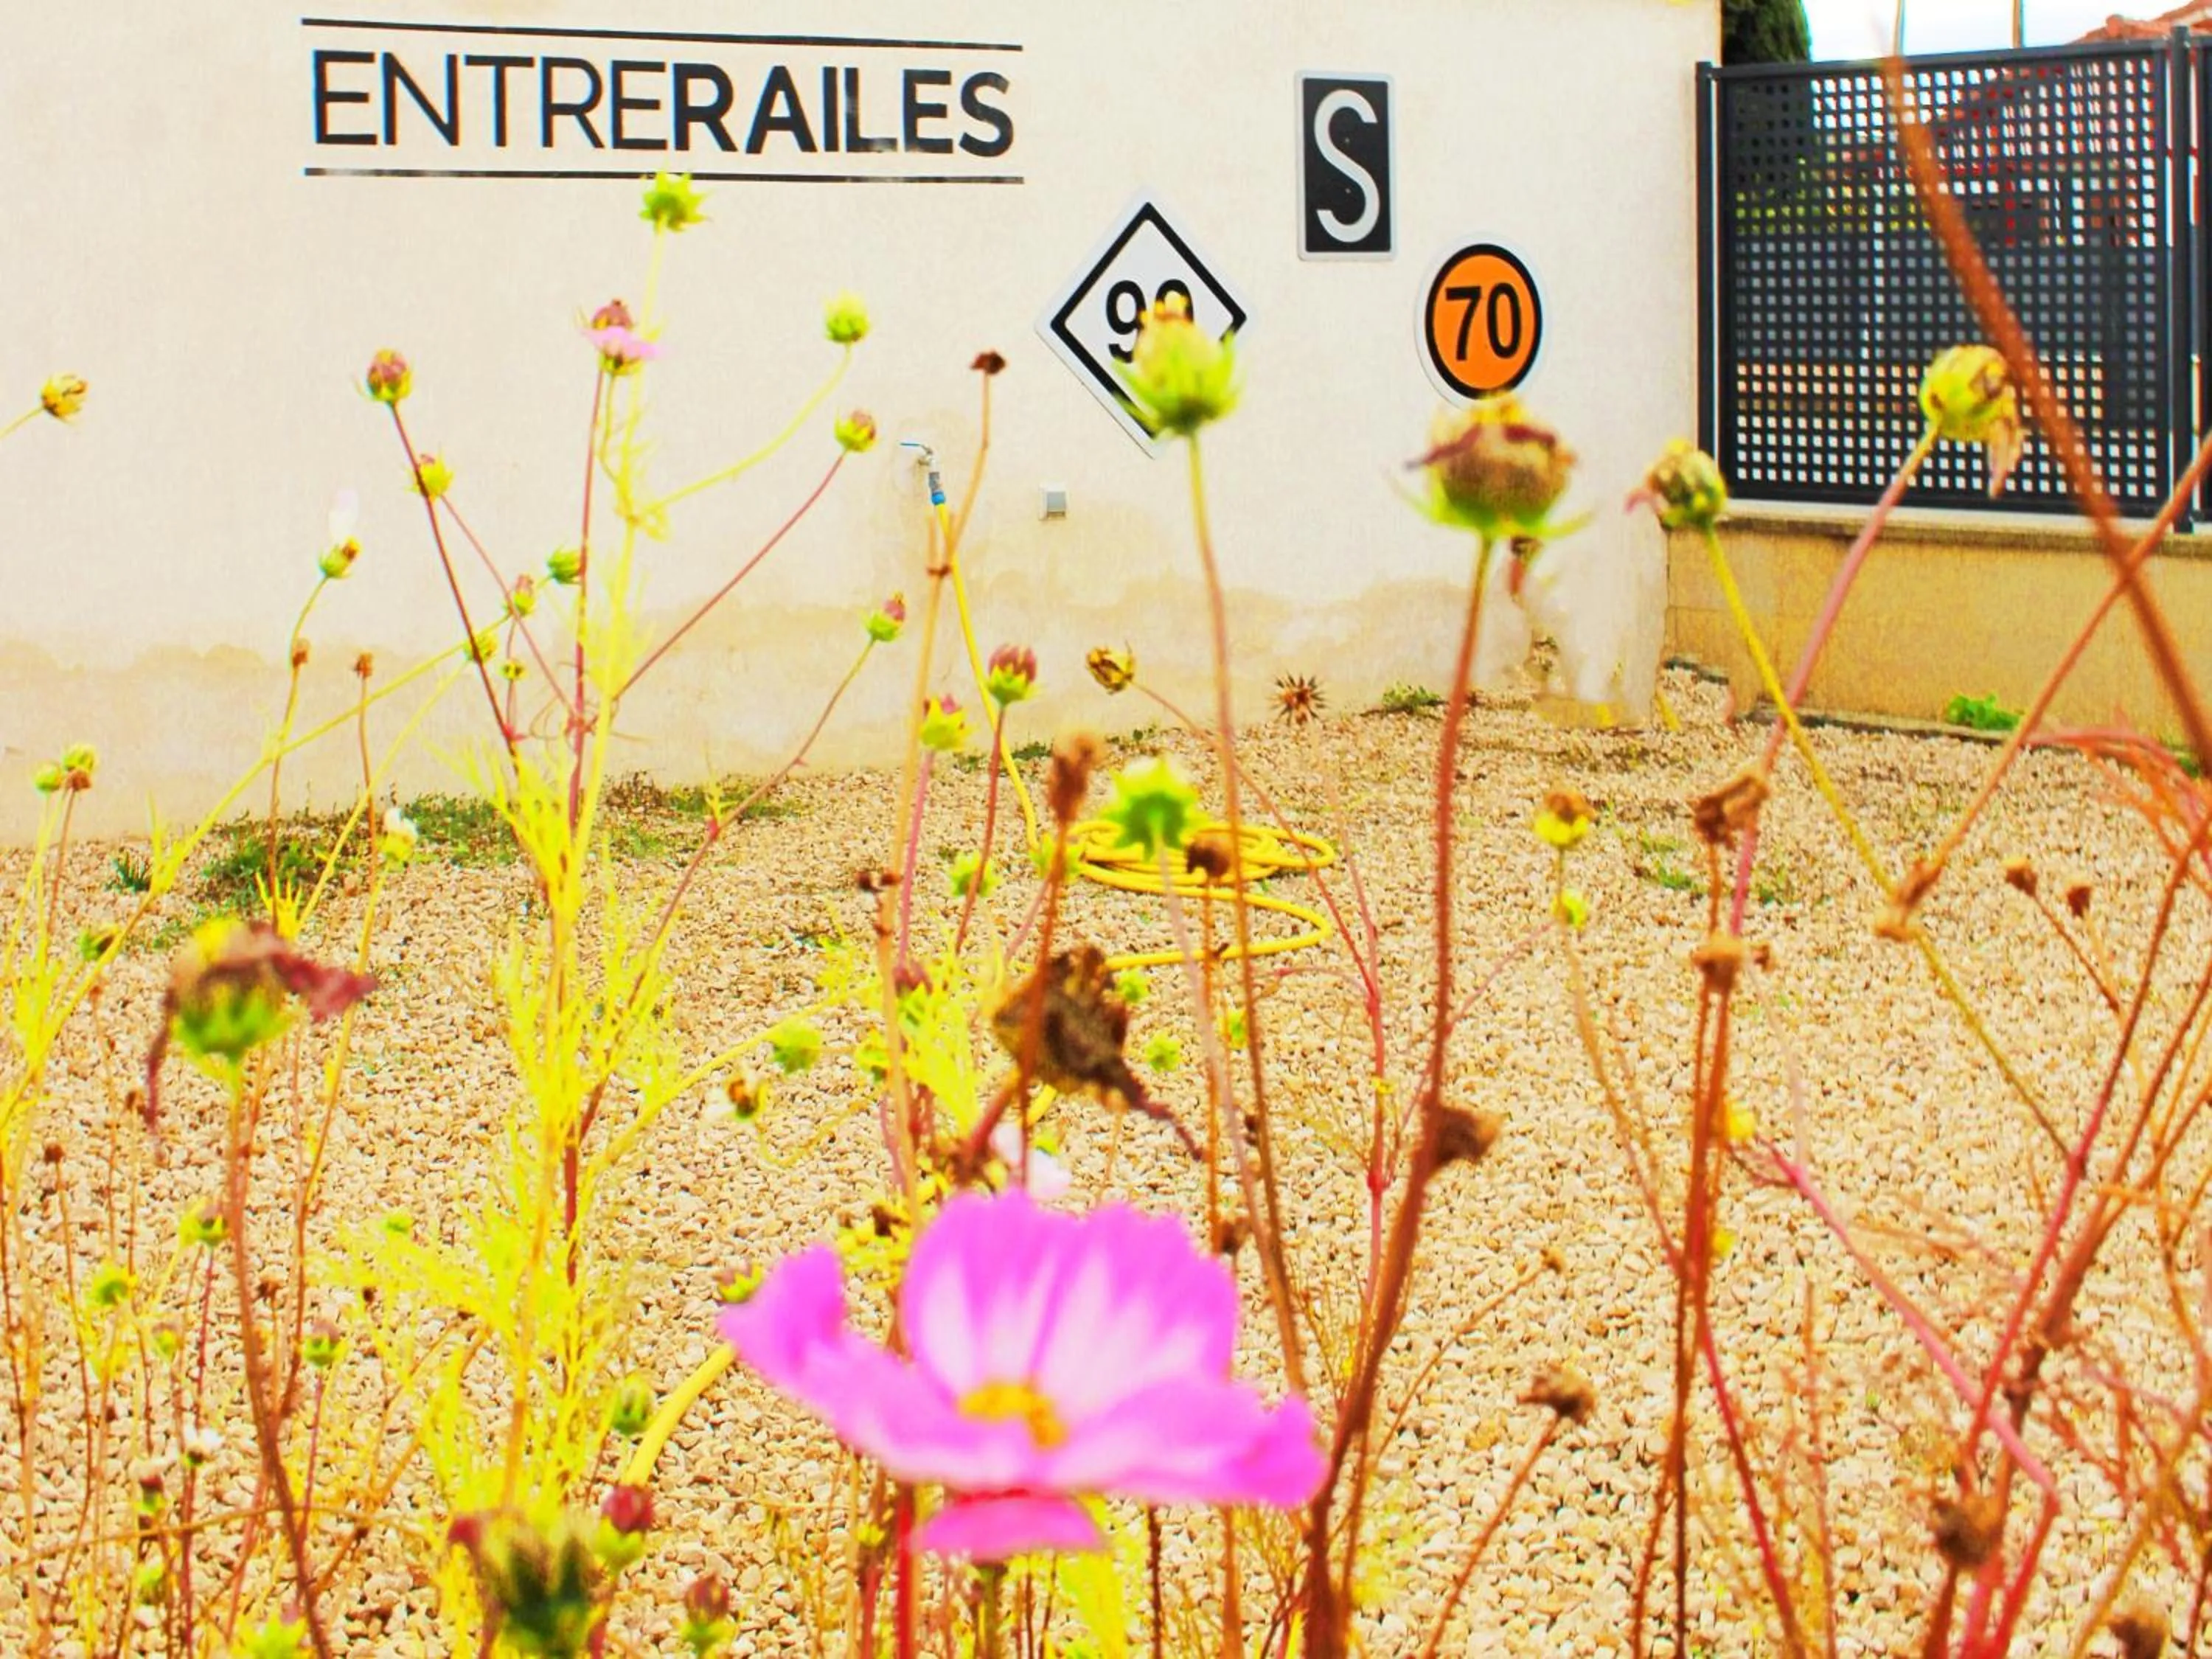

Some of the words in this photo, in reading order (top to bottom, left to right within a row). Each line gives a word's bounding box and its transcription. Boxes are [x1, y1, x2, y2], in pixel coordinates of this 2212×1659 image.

[311, 49, 1015, 158] ENTRERAILES
[1314, 88, 1380, 243] S
[1445, 282, 1522, 361] 70
